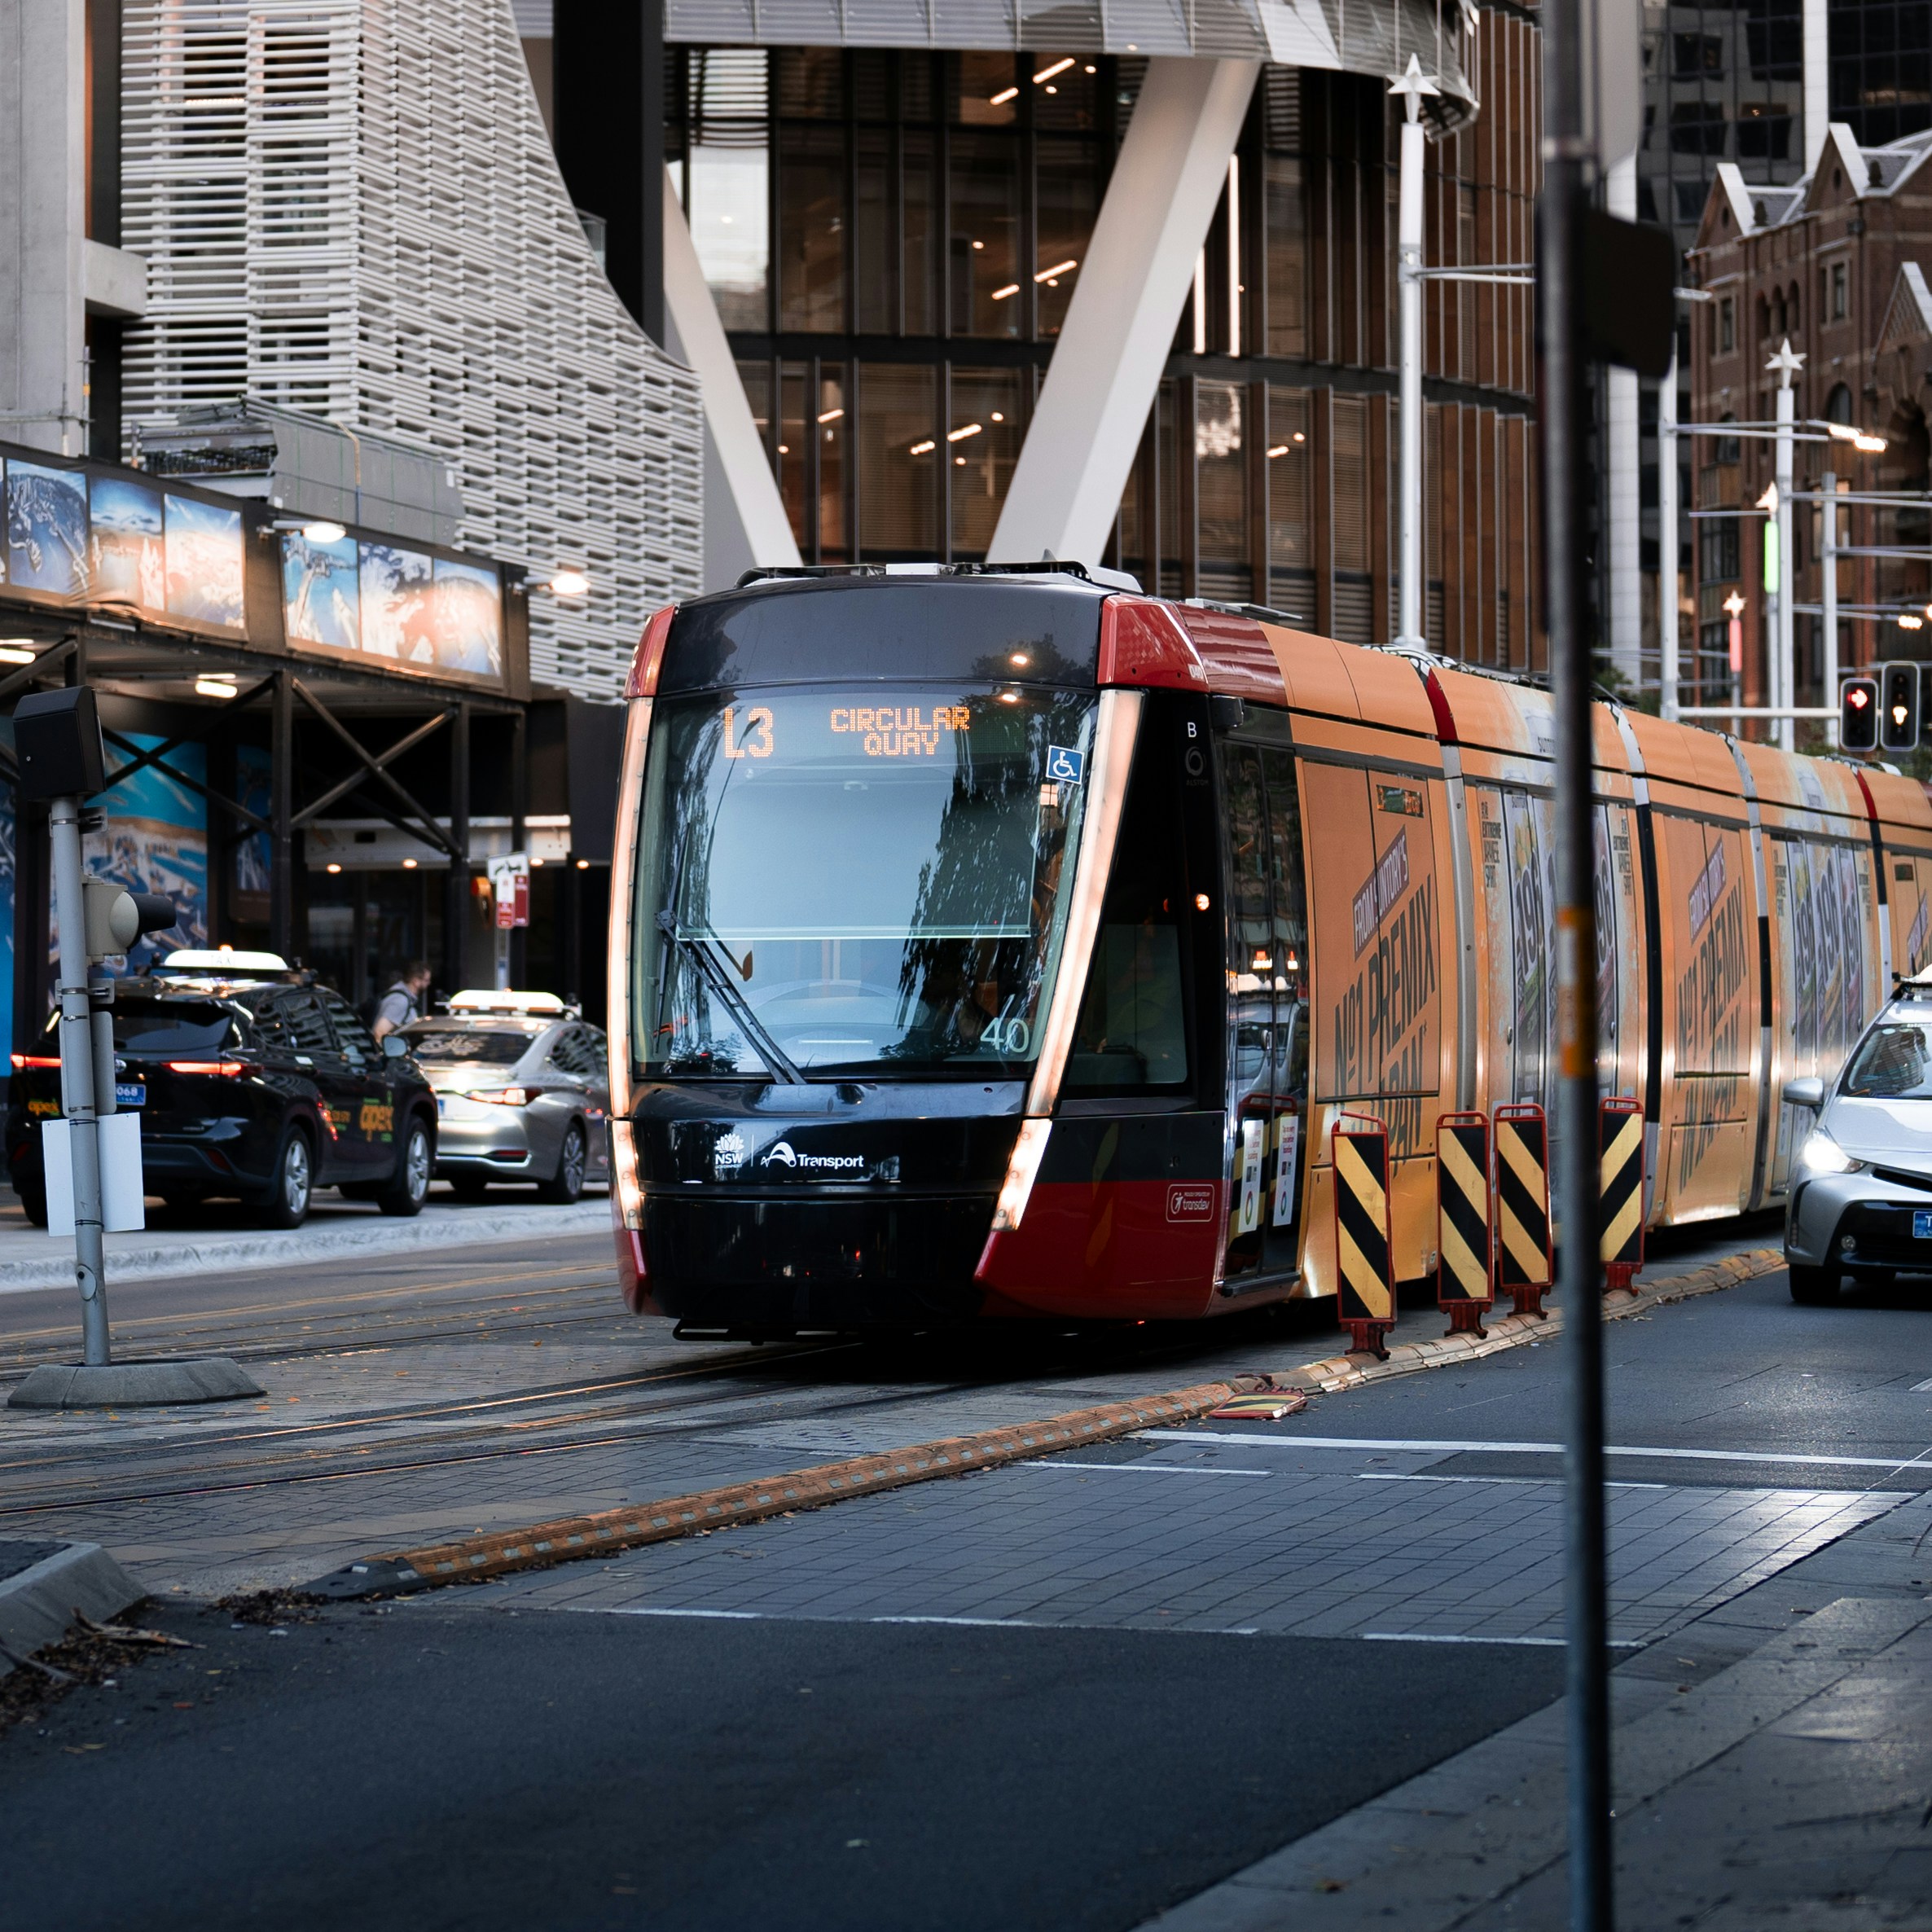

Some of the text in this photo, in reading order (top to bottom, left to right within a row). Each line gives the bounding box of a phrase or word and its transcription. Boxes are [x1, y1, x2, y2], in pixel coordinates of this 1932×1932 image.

[724, 706, 971, 758] L3 CIRCULAR
[863, 731, 939, 756] QUAY
[1187, 722, 1197, 738] B
[1354, 881, 1375, 952] FROM
[1368, 874, 1436, 1083] PREMIX
[1701, 876, 1746, 1051] PREMIX
[980, 1017, 1030, 1053] 40
[715, 1153, 744, 1165] NSW
[797, 1154, 864, 1170] Transport
